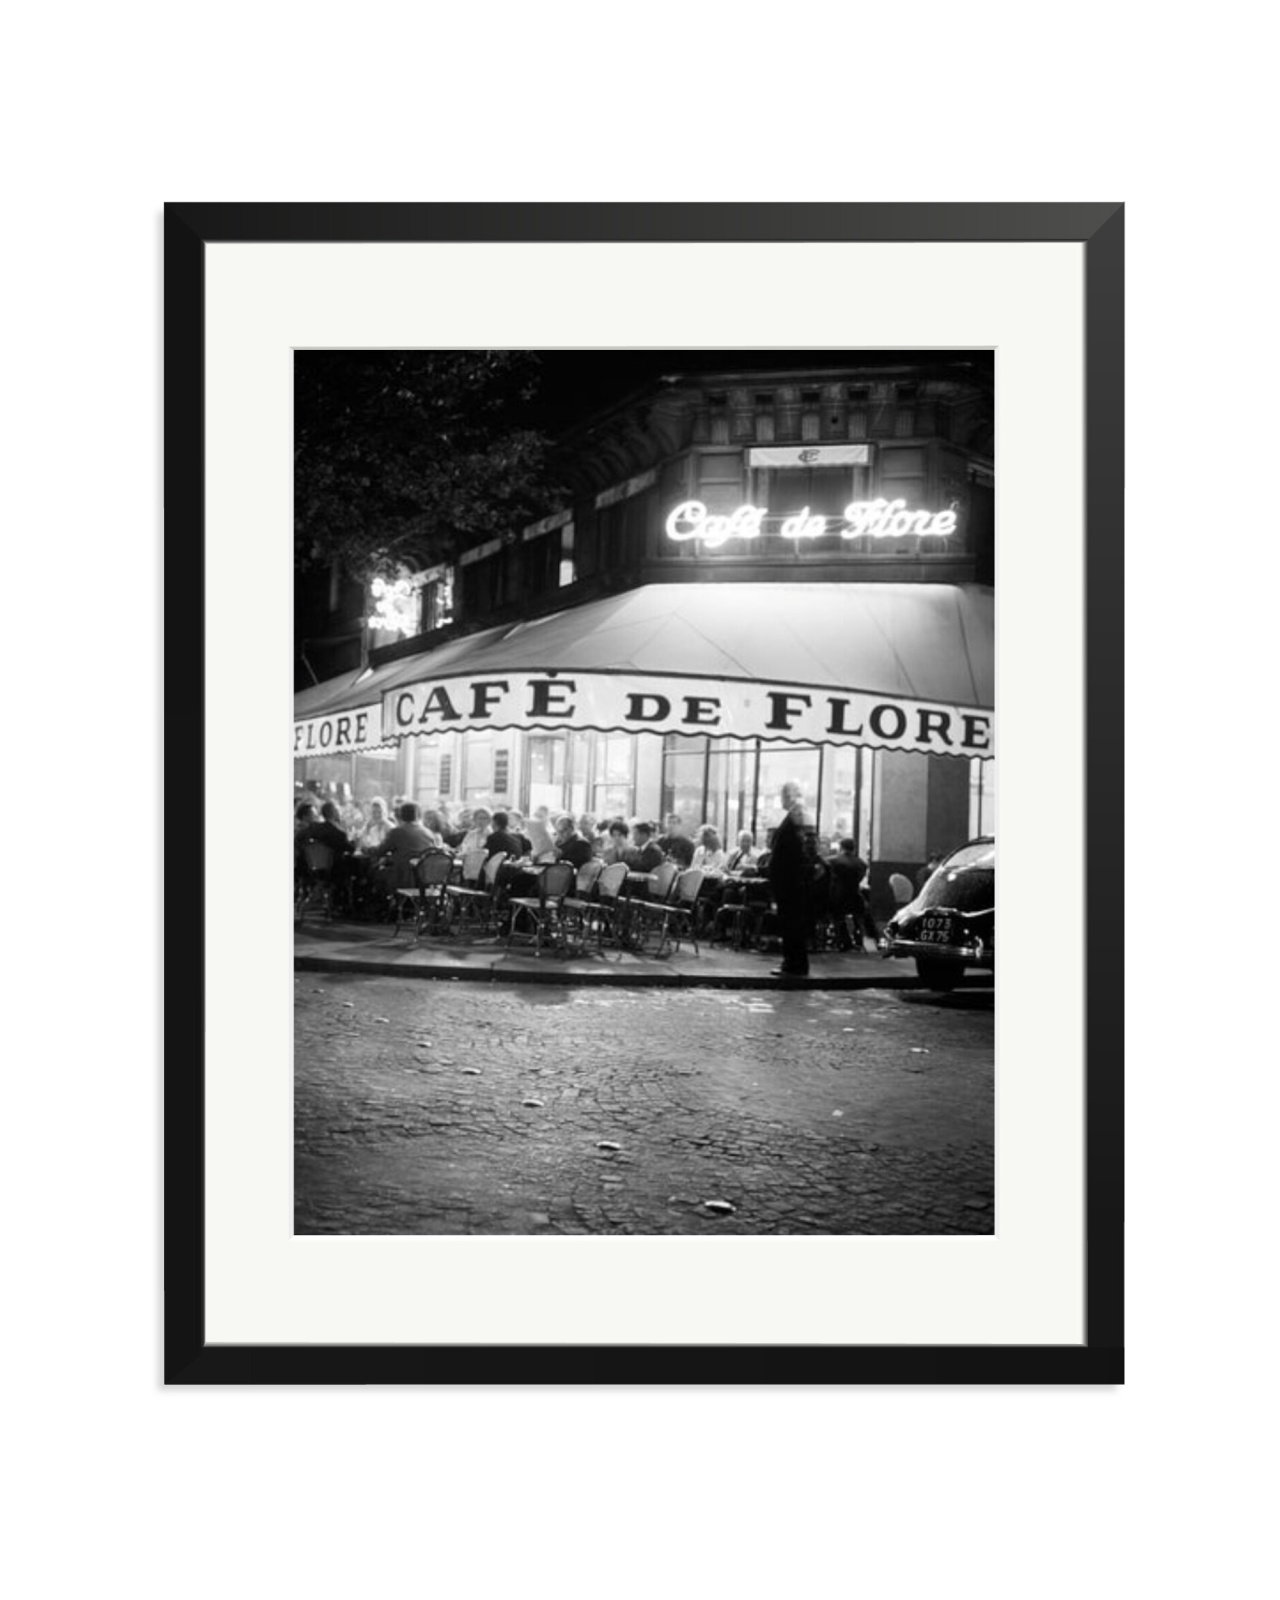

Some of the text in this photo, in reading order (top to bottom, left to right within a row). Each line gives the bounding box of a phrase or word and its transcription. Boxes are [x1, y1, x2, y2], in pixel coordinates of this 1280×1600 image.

[780, 506, 827, 539] de
[840, 498, 957, 539] Flore
[294, 713, 369, 751] FLORE
[625, 692, 722, 726] DE
[765, 692, 991, 750] FLORE
[922, 917, 952, 930] 1073
